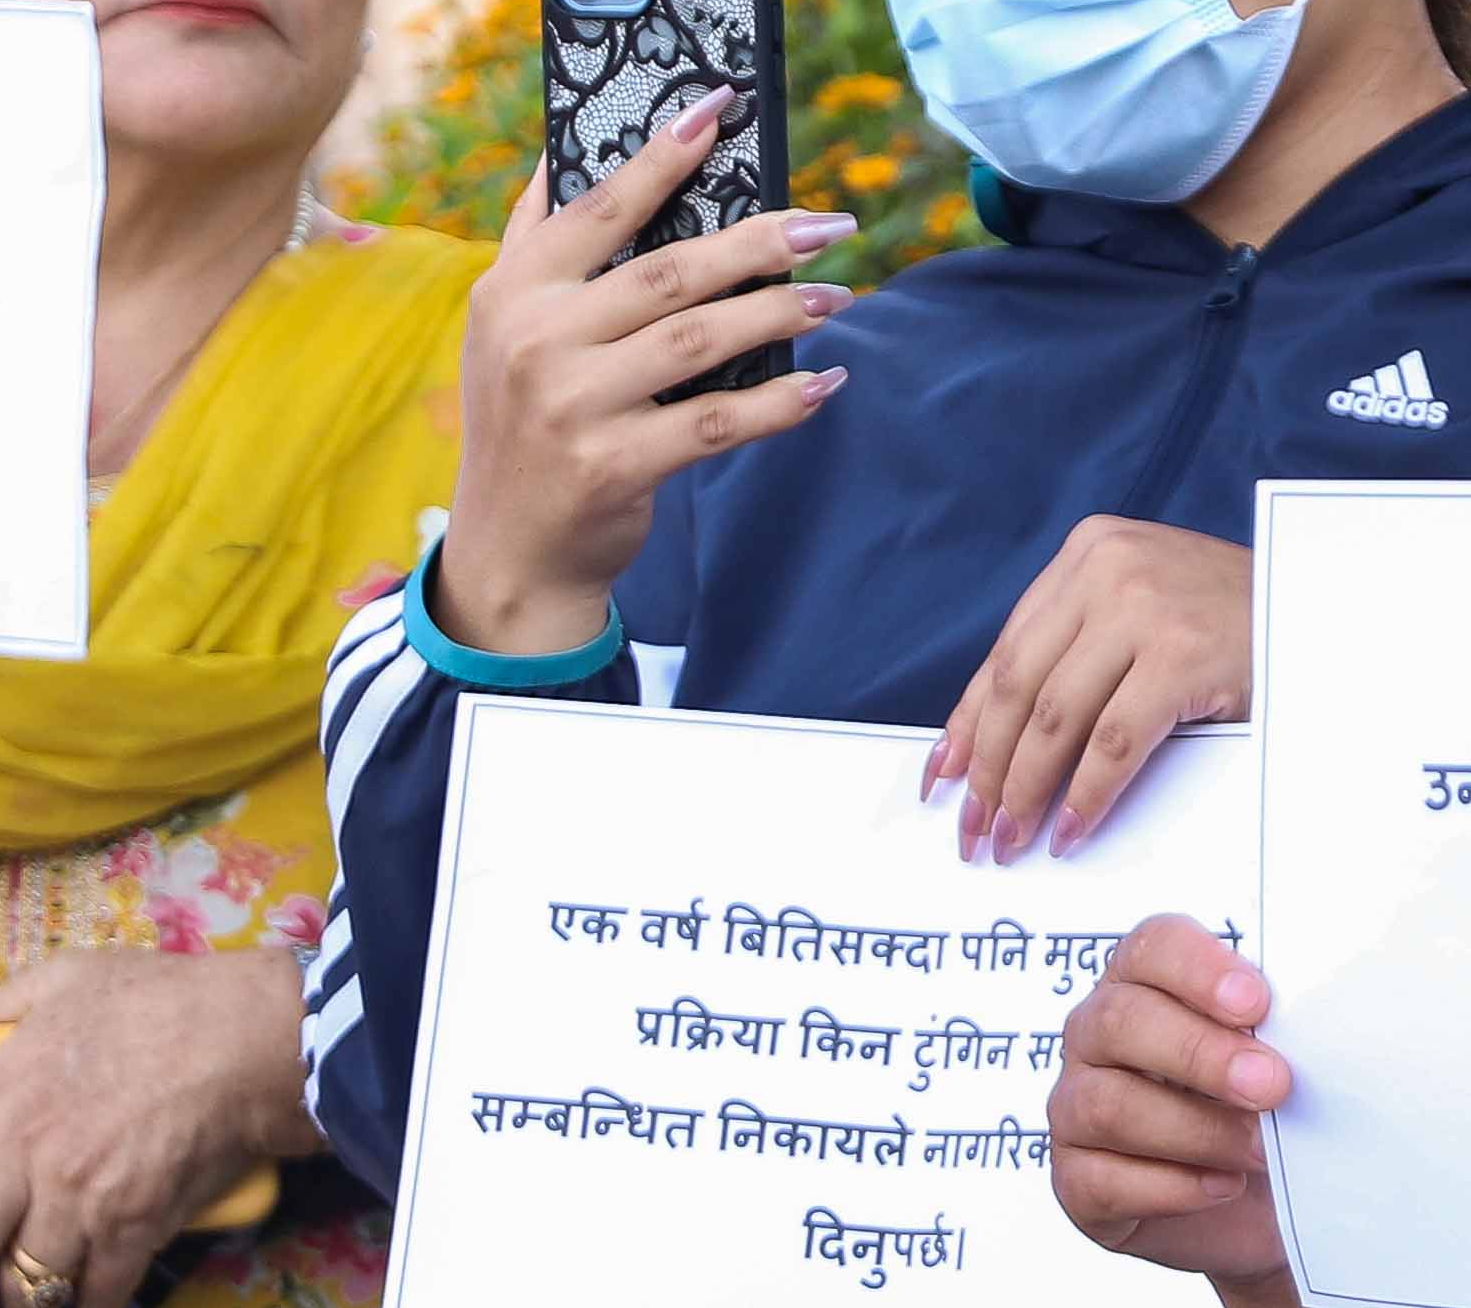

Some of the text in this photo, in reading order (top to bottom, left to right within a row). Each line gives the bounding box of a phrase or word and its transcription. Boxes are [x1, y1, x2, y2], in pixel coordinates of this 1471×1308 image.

[1326, 390, 1450, 430] adidas
[547, 901, 629, 944] एक
[640, 897, 711, 952] वर्ष
[722, 901, 950, 974] बितिसक्दा
[960, 917, 1036, 972] पनि
[635, 995, 787, 1057] प्रक्रिया
[798, 1005, 903, 1067] किन
[907, 1014, 1020, 1093] टुंगिन
[470, 1086, 706, 1150] सम्बन्धित
[716, 1098, 916, 1168] निकायले
[802, 1205, 966, 1290] दिनुपर्छ।
